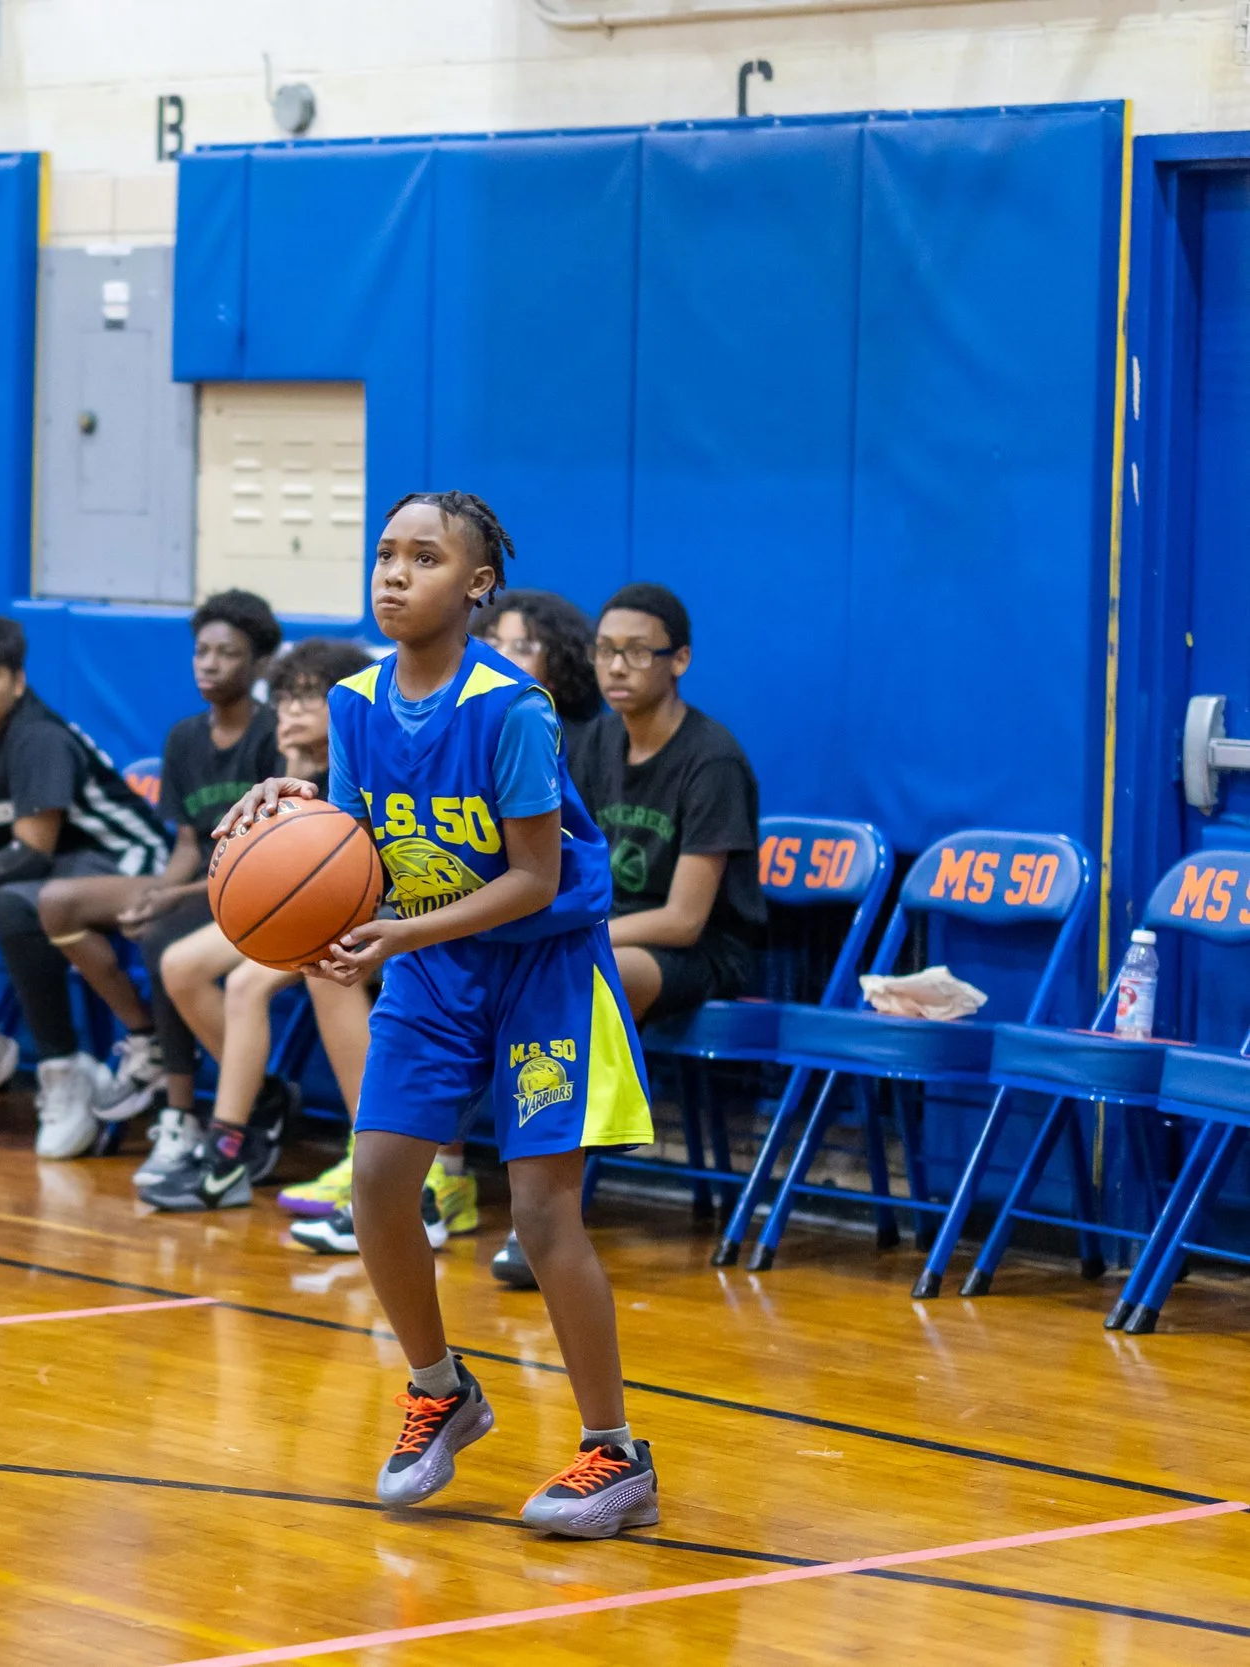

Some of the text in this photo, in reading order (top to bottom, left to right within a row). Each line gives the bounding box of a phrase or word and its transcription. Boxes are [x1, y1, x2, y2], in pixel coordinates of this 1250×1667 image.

[158, 95, 184, 161] B
[431, 796, 502, 854] 50
[804, 839, 857, 889] 50
[929, 848, 1060, 905] MS 50
[1169, 865, 1239, 923] MS
[510, 1039, 577, 1069] M.S. 50
[515, 1083, 573, 1126] WARRIORS
